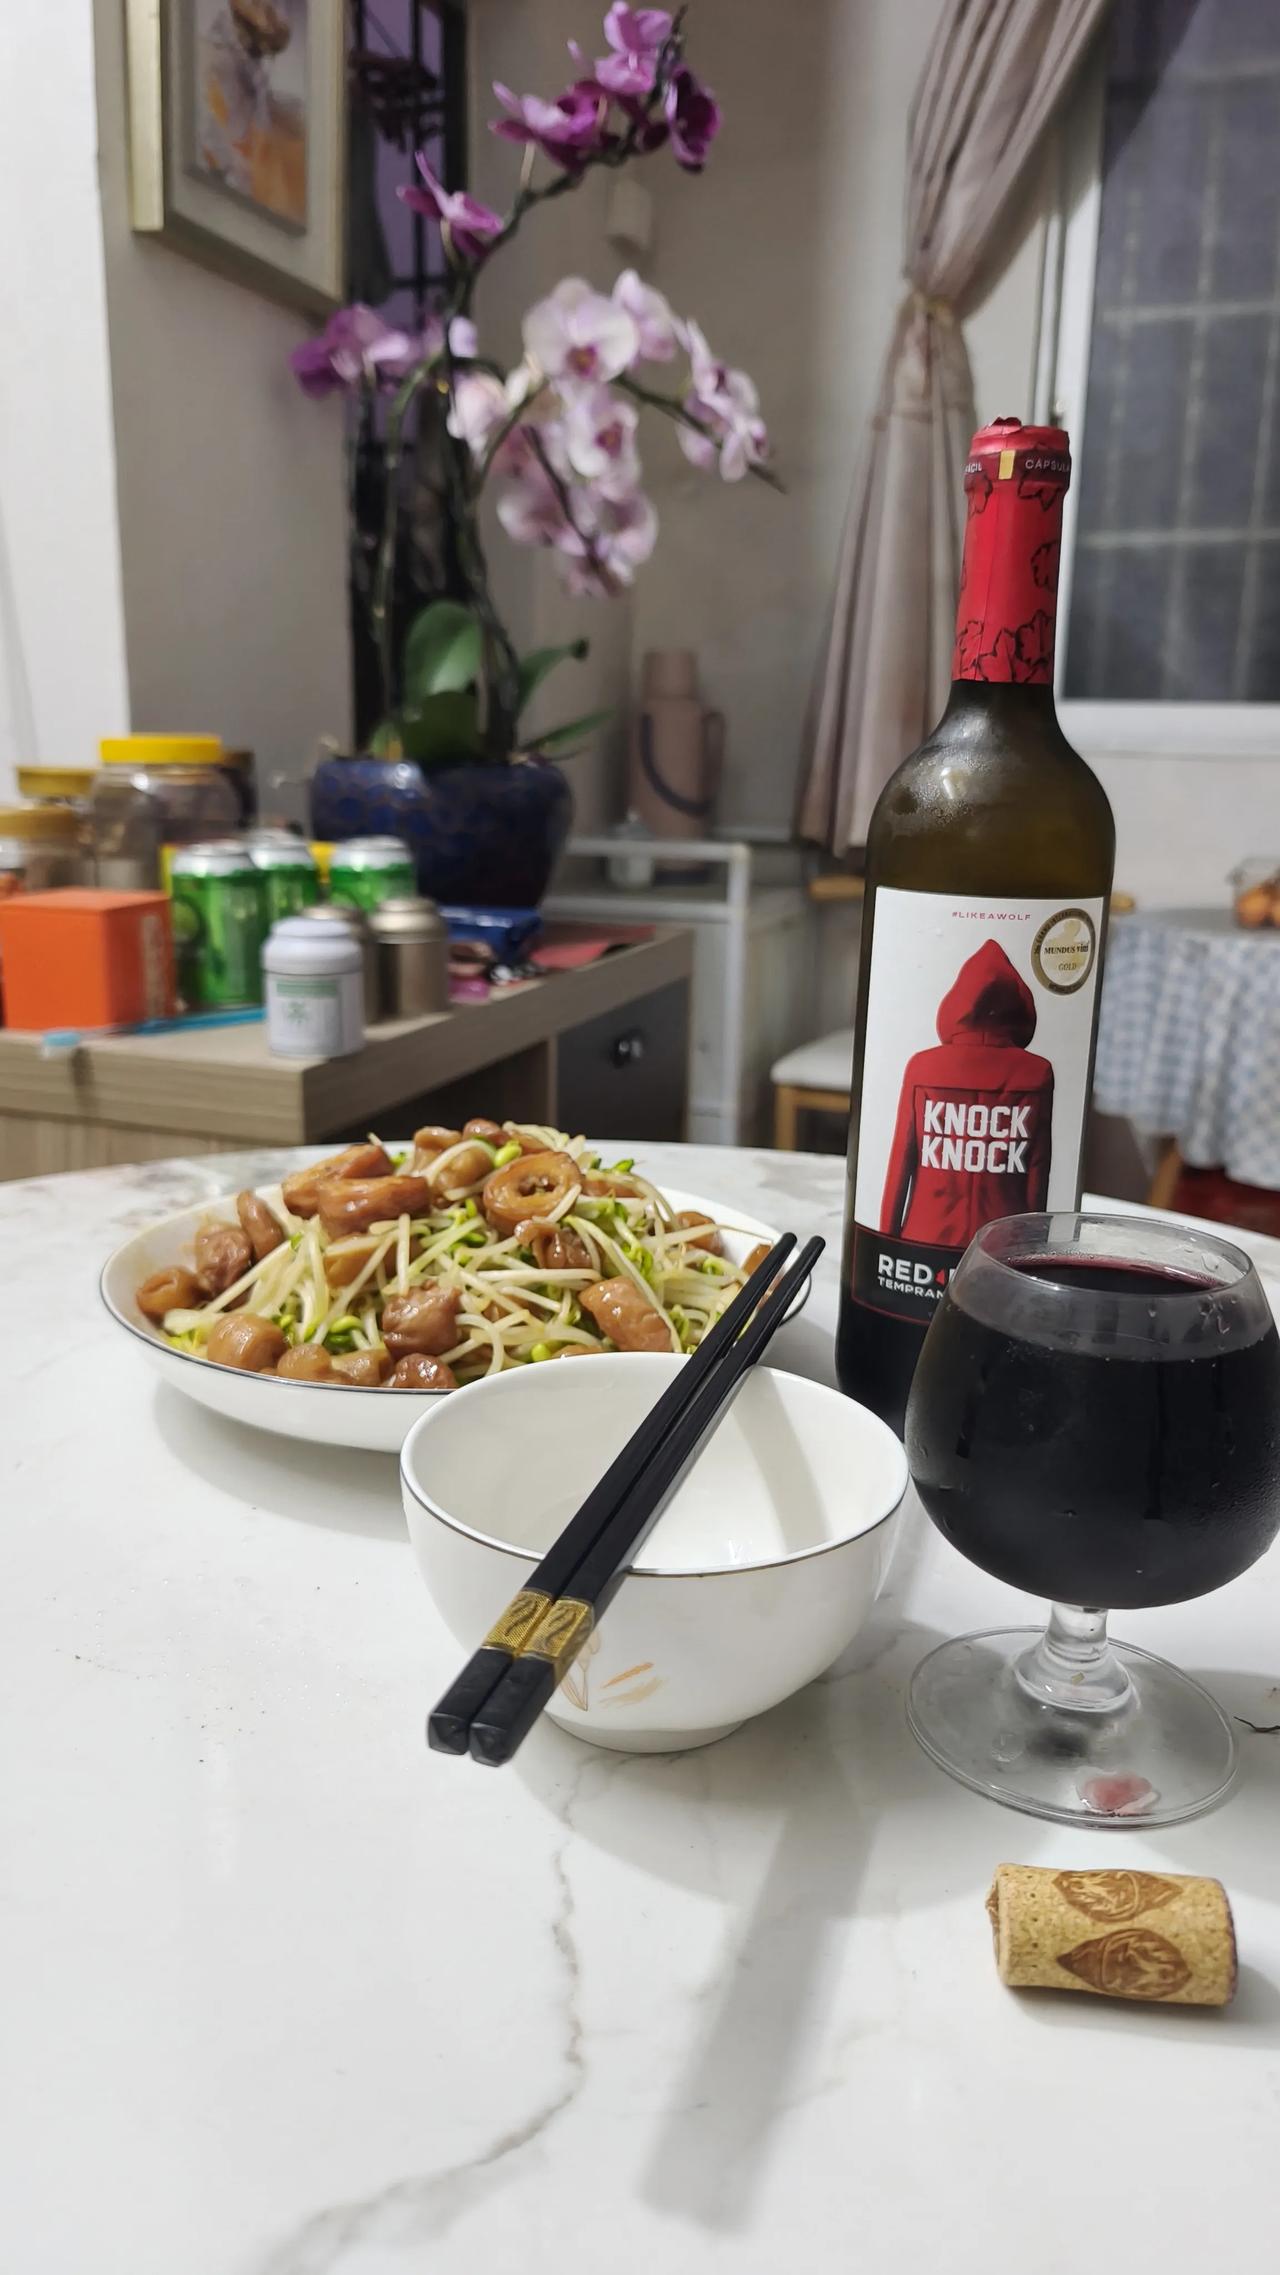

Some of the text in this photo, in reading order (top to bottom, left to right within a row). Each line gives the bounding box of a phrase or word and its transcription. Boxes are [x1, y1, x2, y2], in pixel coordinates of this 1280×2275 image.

[952, 911, 1031, 921] #LIKEAWOLF
[1044, 946, 1076, 955] MUNDUS
[1058, 962, 1077, 971] GOLD
[923, 1100, 1031, 1138] KNOCK
[921, 1135, 1028, 1173] KNOCK
[878, 1253, 933, 1285] RED
